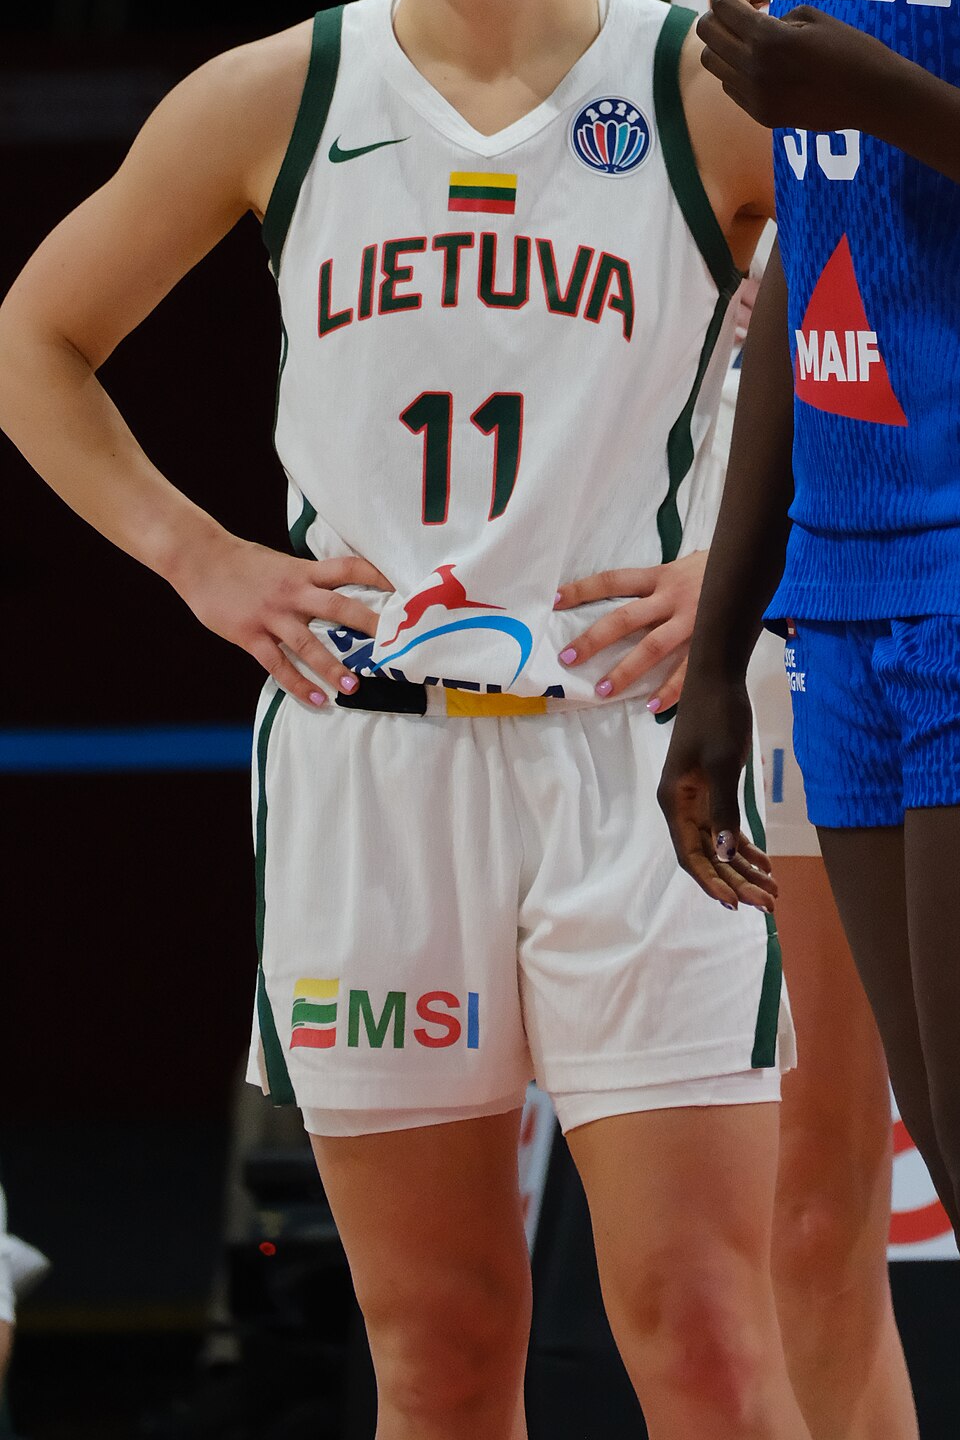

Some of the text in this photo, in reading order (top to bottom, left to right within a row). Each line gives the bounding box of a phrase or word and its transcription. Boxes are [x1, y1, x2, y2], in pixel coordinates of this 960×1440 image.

[585, 101, 641, 124] 2025
[317, 231, 636, 343] LIETUVA
[794, 329, 881, 382] MAIF
[399, 391, 524, 526] 11
